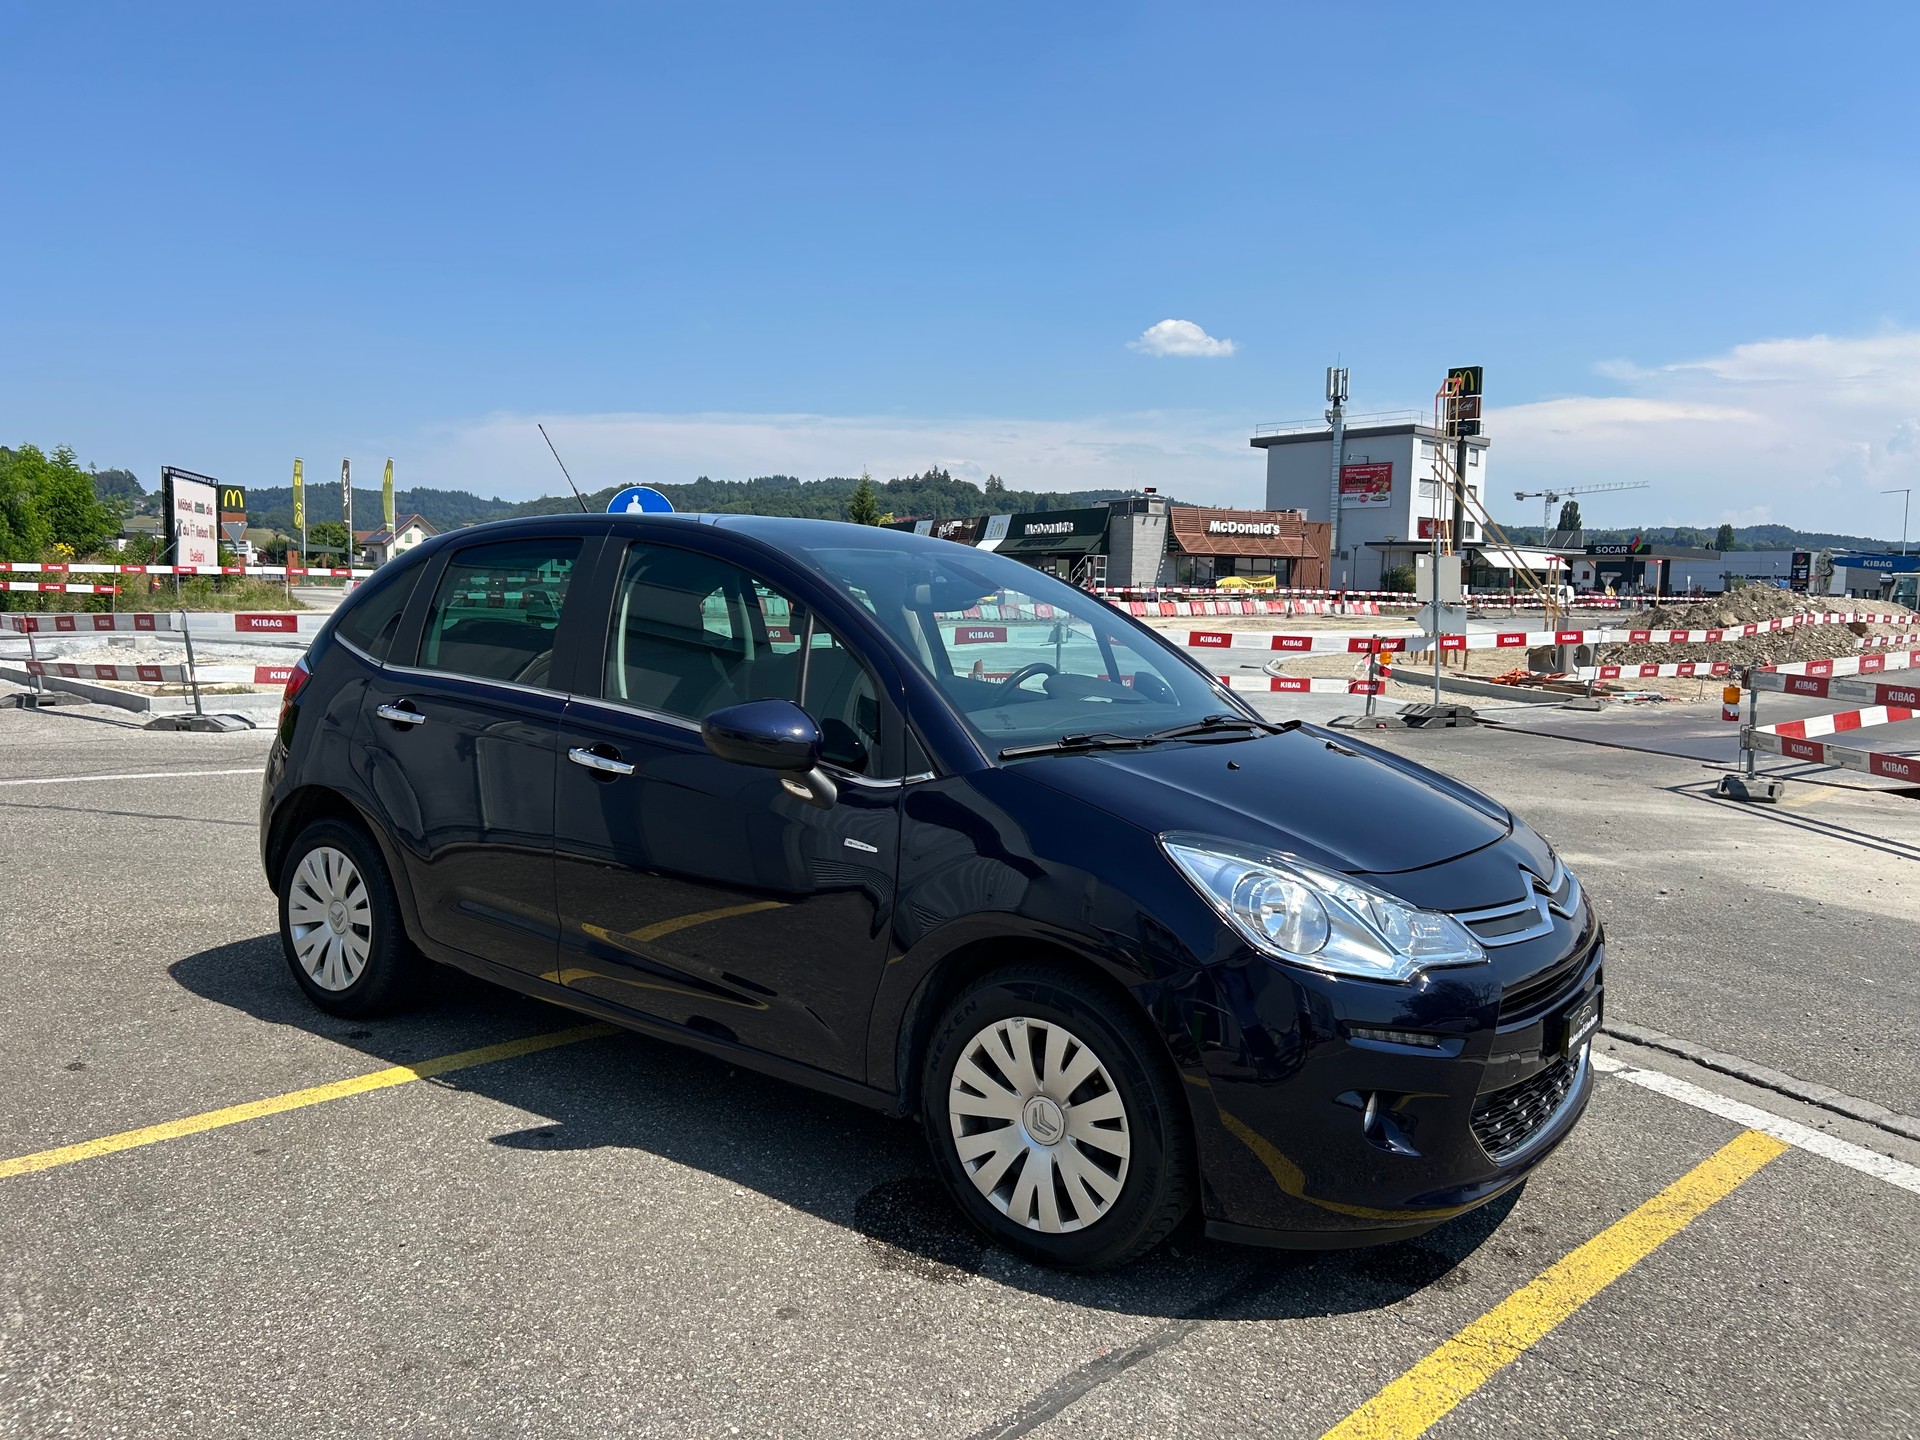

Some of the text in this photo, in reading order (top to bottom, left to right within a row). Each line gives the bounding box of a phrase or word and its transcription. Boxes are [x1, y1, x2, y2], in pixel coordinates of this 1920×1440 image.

[177, 499, 193, 513] Möbel,
[183, 524, 209, 539] du liebst
[1209, 521, 1280, 535] McDonald's
[1595, 546, 1628, 554] SOCAR
[1863, 560, 1893, 568] KIBAG
[251, 619, 283, 627] KIBAG
[968, 631, 995, 639] KIBAG
[1561, 633, 1577, 641] KIBAG
[1200, 636, 1222, 644] KIBAG
[1282, 639, 1303, 647] KIBAG
[1865, 659, 1879, 668] KIBAG
[1812, 665, 1827, 674] KIBAG
[270, 671, 291, 679] KIBA
[1280, 681, 1301, 689] KIBAG
[1794, 680, 1818, 692] KIBAG
[1888, 691, 1916, 703] KIBAG
[1791, 743, 1814, 756] KIBAG
[1882, 760, 1909, 775] KIBAG
[930, 1000, 978, 1072] NEXEN
